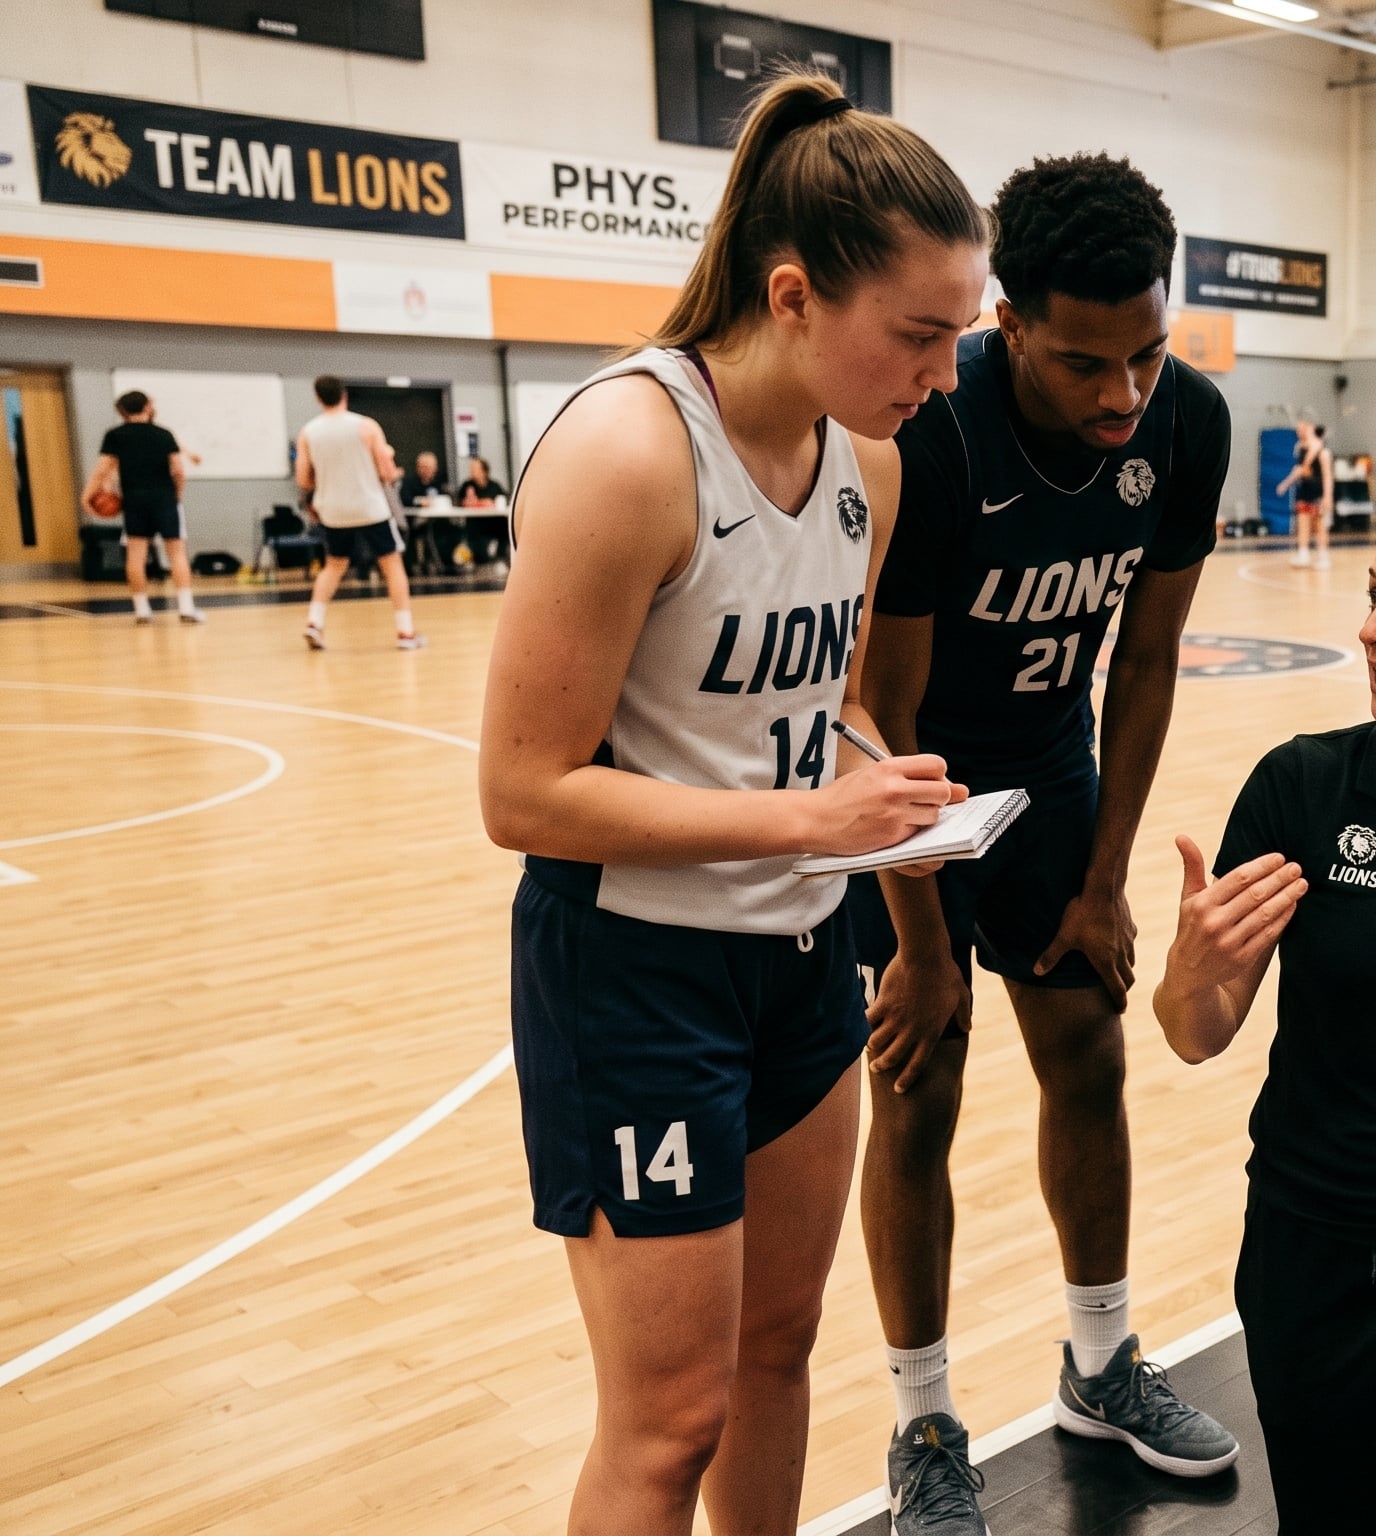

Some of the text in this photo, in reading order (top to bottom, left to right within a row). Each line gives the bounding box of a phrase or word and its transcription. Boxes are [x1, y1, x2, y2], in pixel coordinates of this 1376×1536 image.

[144, 128, 451, 216] TEAM LIONS
[553, 162, 690, 213] PHYS.
[503, 203, 709, 242] PERFORMANC
[968, 546, 1144, 622] LIONS
[1012, 632, 1081, 692] 21
[769, 710, 827, 790] 14
[614, 1120, 694, 1201] 14
